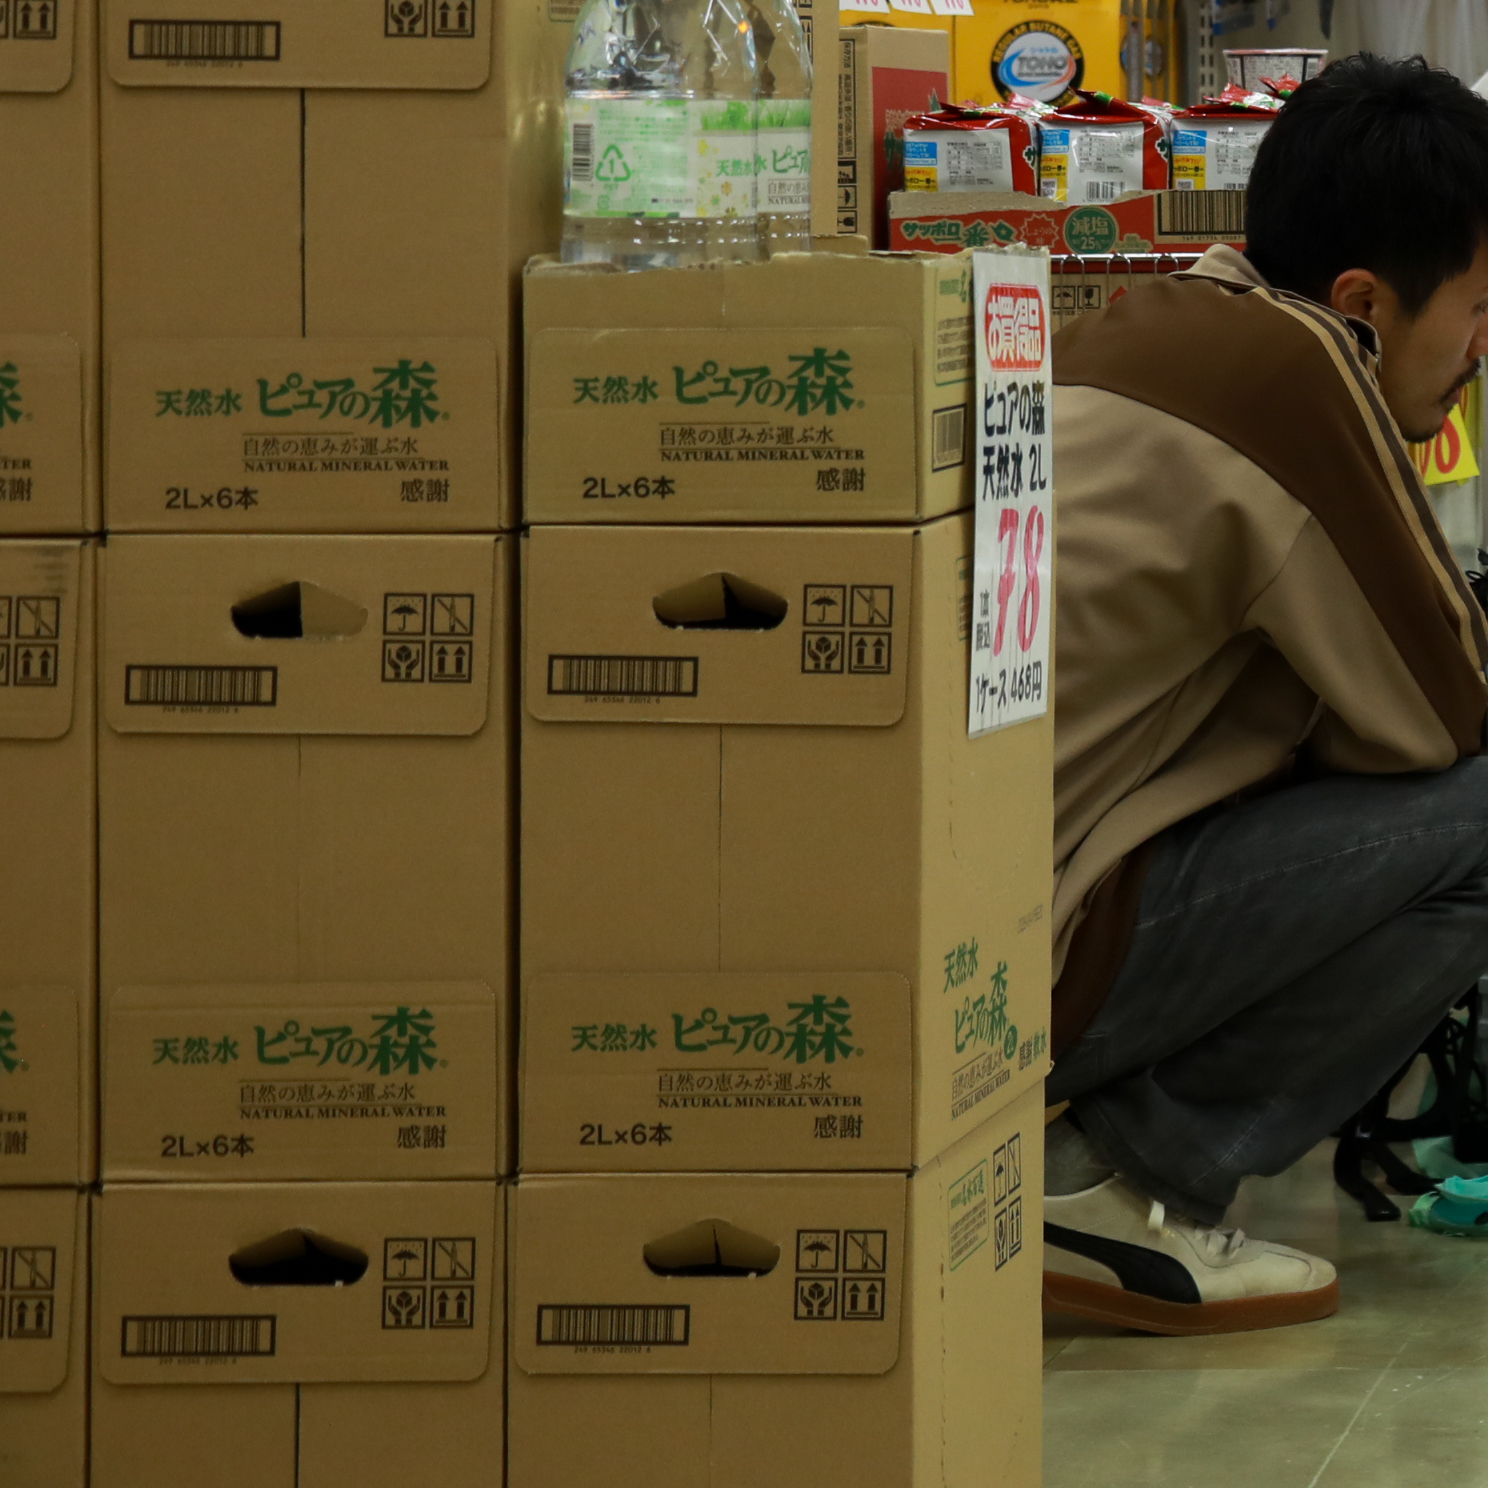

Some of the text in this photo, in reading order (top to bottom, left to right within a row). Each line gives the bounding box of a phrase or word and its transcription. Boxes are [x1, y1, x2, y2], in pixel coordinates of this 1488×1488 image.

[1016, 55, 1067, 71] TOHO
[1072, 218, 1109, 236] 減塩
[987, 299, 1045, 362] お買得品
[155, 359, 440, 429] 天然水 ピュアの森
[573, 347, 856, 416] 天然水 ピュアの森
[983, 381, 1047, 439] ピュアの森
[242, 436, 419, 458] 自然の恵みが運ぶ水
[658, 426, 835, 447] 自然の恵みが運ぶ水
[244, 459, 450, 472] NATURAL MINERAL WATER
[660, 449, 866, 462] NATURAL MINERAL WATER
[815, 466, 866, 492] 感謝
[982, 443, 1047, 503] 天然水 2L
[400, 478, 450, 503] 感謝
[991, 505, 1045, 657] 78
[1009, 660, 1043, 704] 468円
[943, 936, 979, 994] 天然水
[954, 961, 1009, 1055] ピュアの森
[152, 1006, 439, 1075] 天然水 ピュアの森
[570, 994, 855, 1065] 天然水 ピュアの森
[239, 1083, 416, 1102] 自然の恵みが運ぶ水
[657, 1072, 833, 1093] 自然の恵みが運ぶ水
[240, 1106, 447, 1120] NATURAL MINERAL WATER
[658, 1095, 863, 1109] NATURAL MINERAL WATER
[396, 1124, 447, 1149] 感謝
[813, 1114, 864, 1139] 感謝
